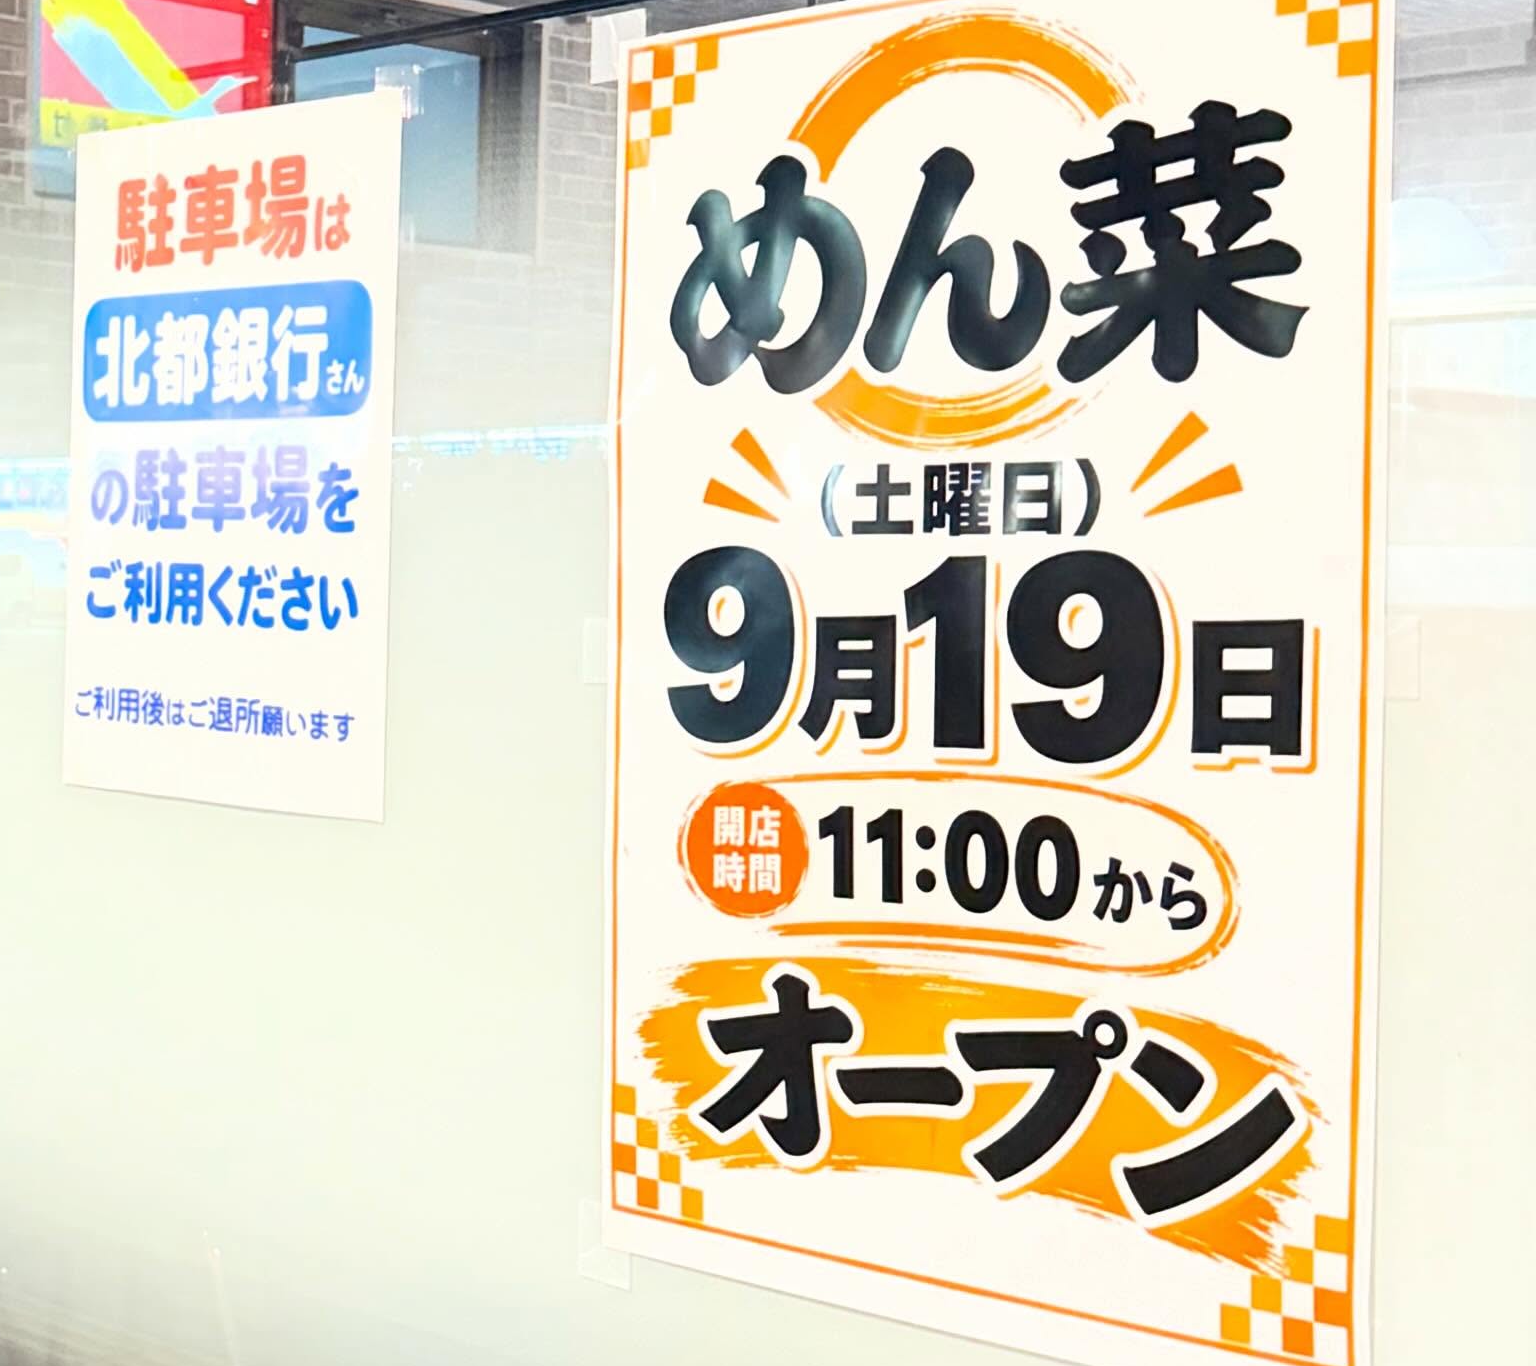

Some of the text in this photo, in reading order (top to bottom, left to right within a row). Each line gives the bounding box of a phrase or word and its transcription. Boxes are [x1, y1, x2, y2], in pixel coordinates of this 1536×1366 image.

[114, 154, 351, 273] 駐車場は
[670, 100, 1310, 394] めん菜
[94, 305, 365, 409] 北都銀行さん
[90, 446, 360, 535] の駐車場を
[819, 455, 1104, 540] (土曜日)
[86, 559, 360, 632] ご利用ください
[663, 547, 1305, 765] 9月19日
[74, 687, 356, 742] ご利用後はご退所願います
[713, 805, 782, 848] 開店
[713, 852, 782, 895] 時間
[818, 805, 1209, 932] 11:00から
[700, 974, 1296, 1216] オープン
